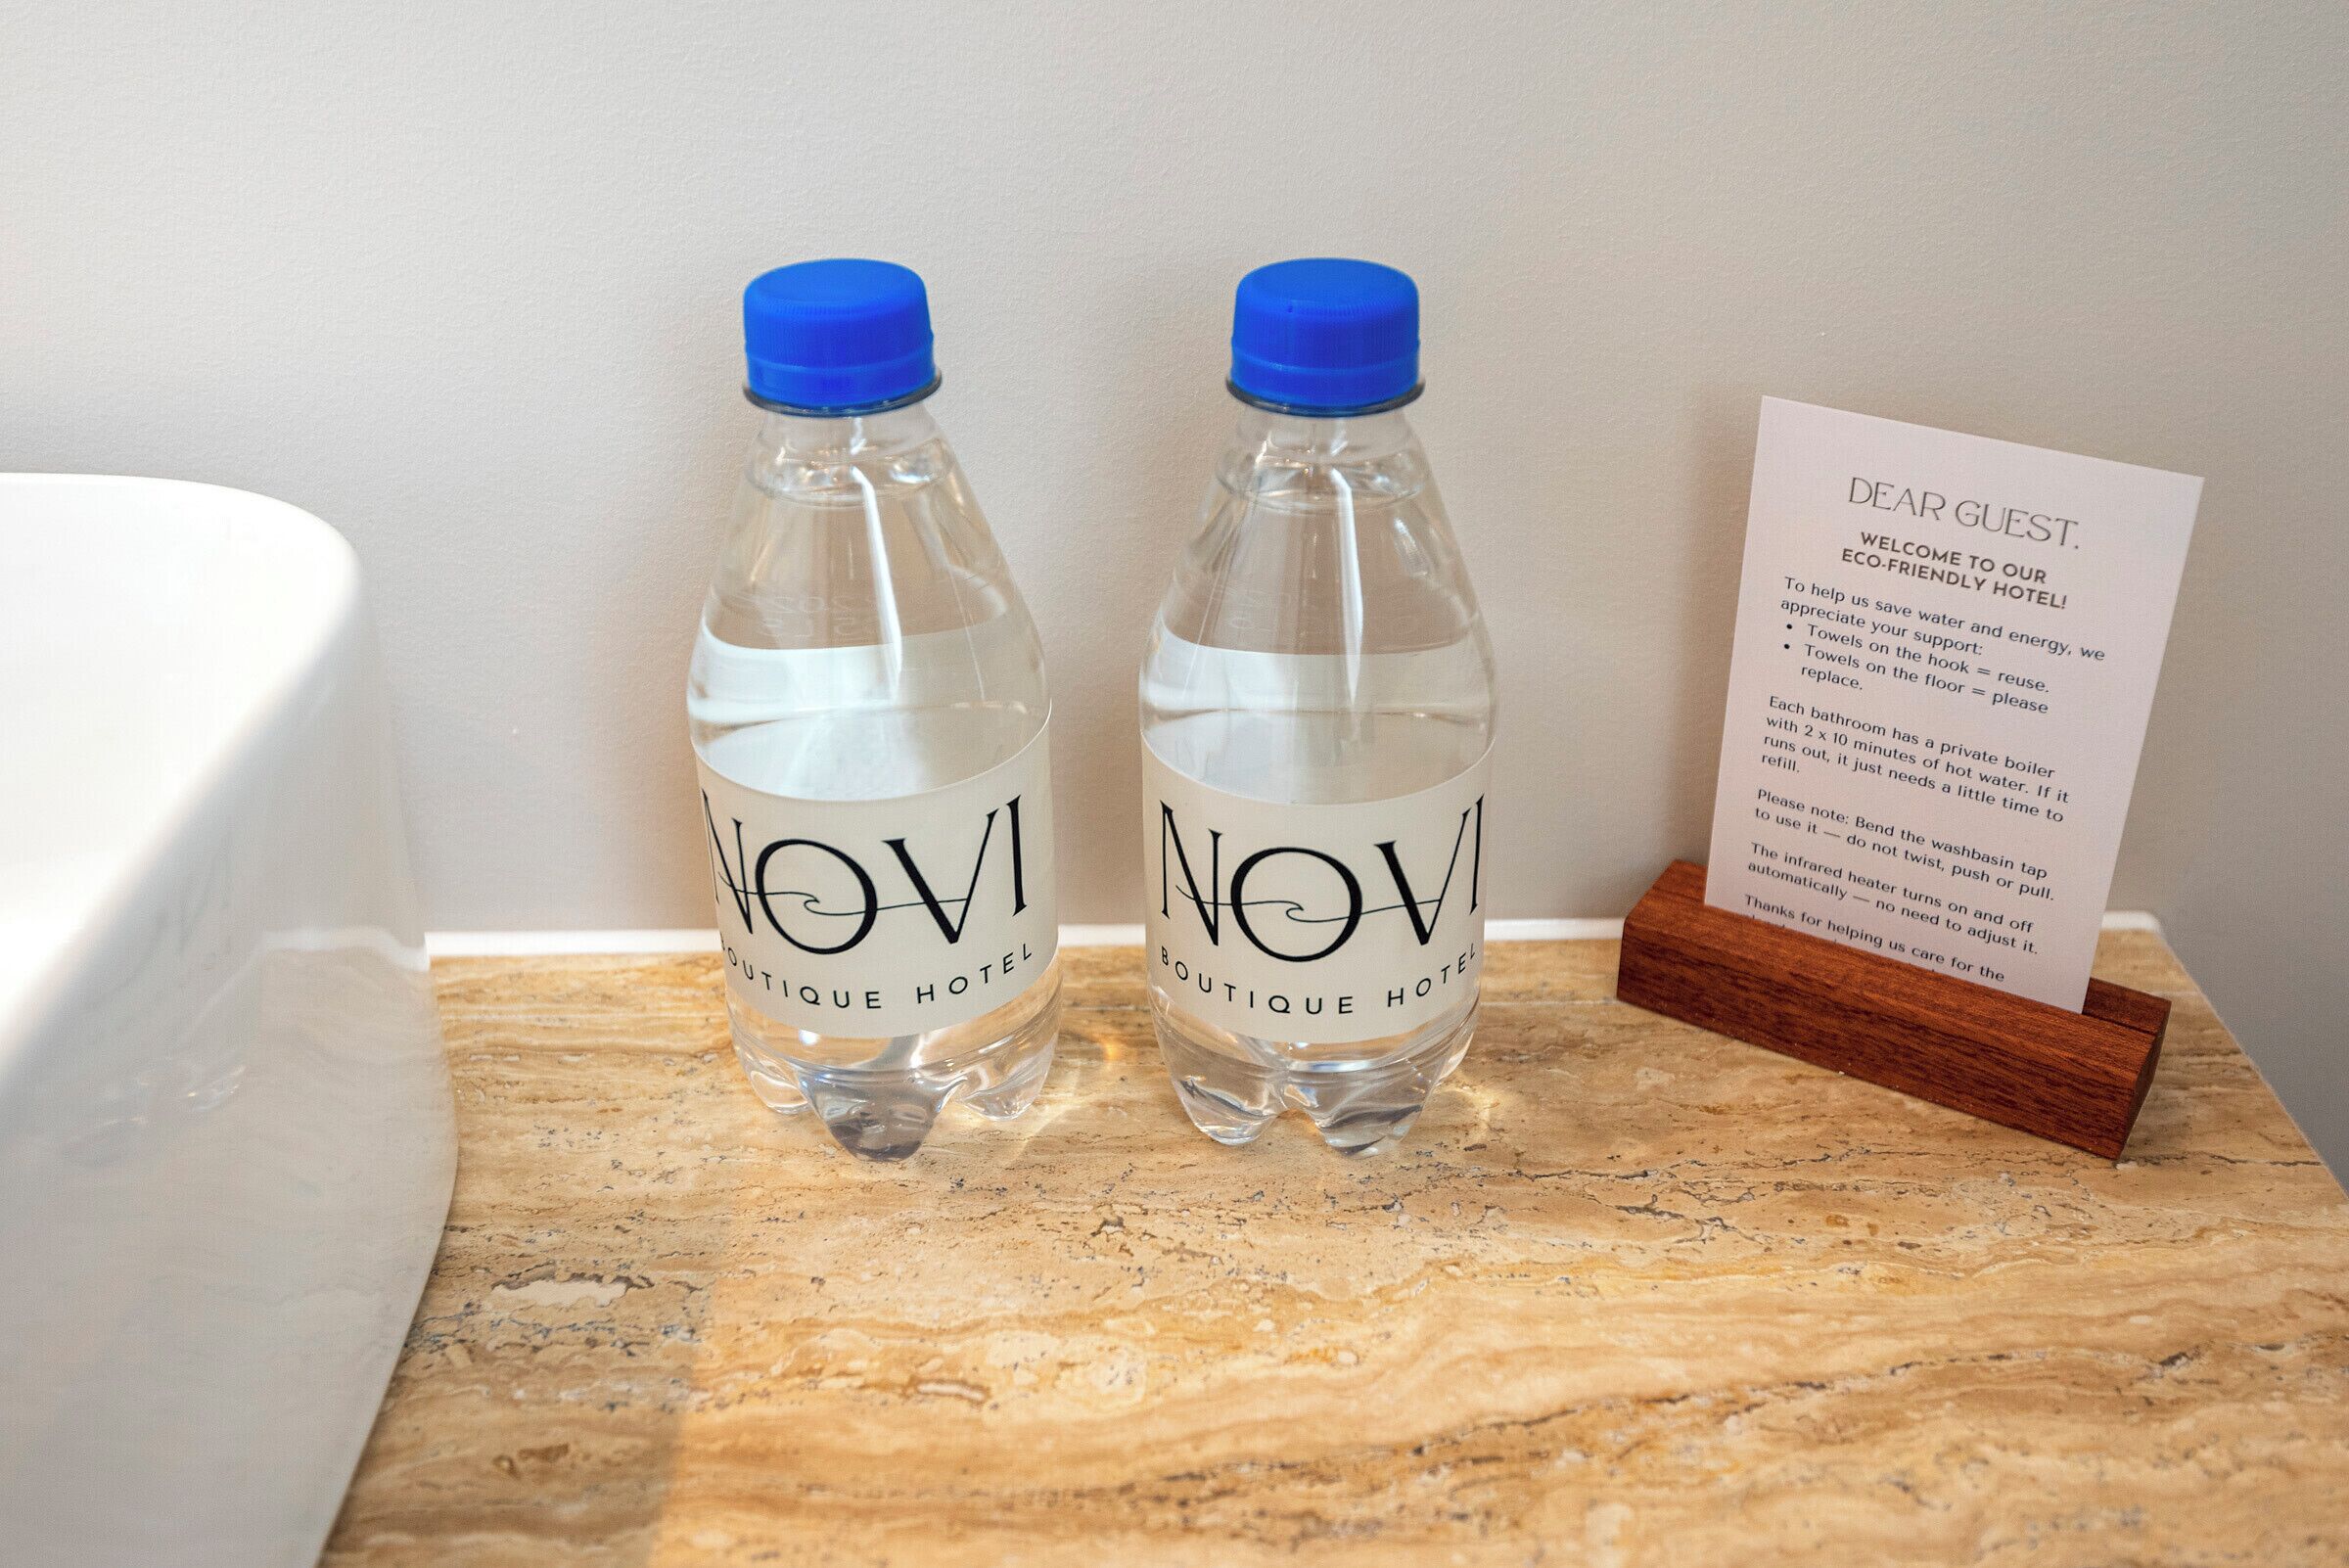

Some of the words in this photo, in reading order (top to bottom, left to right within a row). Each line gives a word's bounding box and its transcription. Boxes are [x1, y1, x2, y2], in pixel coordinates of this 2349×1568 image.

[1848, 476, 1947, 521] DEAR
[1954, 499, 2079, 550] GUEST.
[1840, 547, 1988, 591] ECO-FRIENDLY
[1992, 580, 2067, 610] HOTEL!
[1860, 530, 1962, 567] WELCOME
[1967, 554, 1996, 573] TO
[2001, 562, 2047, 584] OUR
[1779, 599, 1866, 628] appreciate
[1868, 621, 1910, 638] your
[1911, 630, 1983, 656] support:
[1783, 576, 1806, 593] To
[1810, 582, 1845, 605] help
[1850, 594, 1869, 609] us
[1873, 600, 1912, 618] save
[1917, 610, 1965, 629] water
[1968, 622, 2004, 638] and
[2007, 630, 2072, 657] energy,
[2079, 646, 2105, 662] we
[1806, 623, 1863, 649] Towels
[1867, 641, 1889, 655] on
[1895, 645, 1922, 663] the
[1926, 651, 1969, 674] hook
[1997, 672, 2050, 693] reuse.
[1801, 666, 1863, 691] replace.
[1803, 642, 1860, 669] Towels
[1865, 662, 1886, 675] on
[1892, 666, 1919, 683] the
[1924, 672, 1966, 694] floor
[1991, 692, 2049, 715] please
[1761, 754, 1800, 773] refill.
[1766, 715, 1798, 733] with
[1803, 722, 1814, 738] 2
[1817, 730, 1827, 742] x
[1831, 730, 1848, 748] 10
[1853, 739, 1916, 766] minutes
[1921, 758, 1941, 770] of
[1944, 761, 1973, 779] hot
[1978, 772, 2029, 794] water.
[2036, 784, 2052, 799] If
[2055, 789, 2069, 804] it
[1769, 695, 1805, 715] Each
[1809, 706, 1886, 737] bathroom
[1891, 726, 1919, 746] has
[1924, 738, 1935, 749] a
[1938, 742, 1999, 765] private
[2004, 755, 2055, 778] boiler
[1764, 735, 1796, 753] runs
[1801, 746, 1830, 763] out,
[1837, 752, 1849, 766] it
[1850, 756, 1883, 776] just
[1888, 768, 1936, 790] needs
[1941, 783, 1952, 794] a
[1957, 784, 1996, 806] little
[2001, 796, 2040, 816] time
[2044, 807, 2064, 823] to
[702, 788, 1028, 955] NOVI
[1754, 807, 1771, 821] to
[1775, 813, 1802, 830] use
[1807, 820, 1818, 835] it
[1846, 834, 1866, 849] do
[1871, 841, 1899, 857] not
[1903, 849, 1945, 872] twist,
[1951, 864, 1990, 883] push
[1995, 877, 2014, 889] or
[2017, 882, 2054, 900] pull.
[1757, 788, 1805, 812] Please
[1810, 806, 1849, 825] note:
[1855, 815, 1895, 837] Bend
[1900, 828, 1925, 846] the
[1930, 839, 2014, 870] washbasin
[2020, 861, 2048, 882] tap
[1159, 794, 1485, 963] NOVI
[1747, 861, 1848, 901] automatically
[1874, 899, 1896, 913] no
[1900, 906, 1940, 926] need
[1945, 917, 1962, 932] to
[1966, 926, 2017, 948] adjust
[2022, 940, 2038, 954] it.
[1750, 841, 1778, 860] The
[1783, 851, 1843, 880] infrared
[1847, 869, 1898, 895] heater
[1902, 887, 1942, 908] turns
[1947, 901, 1968, 916] on
[1972, 908, 2004, 926] and
[2008, 919, 2035, 934] off
[916, 943, 1033, 1005] HOTEL
[1160, 945, 1354, 1015] BOUTIQUE
[1387, 943, 1476, 1008] HOTEL
[1744, 894, 1795, 919] Thanks
[1800, 911, 1823, 927] for
[1826, 919, 1883, 949] helping
[1888, 939, 1906, 953] us
[1911, 946, 1945, 964] care
[1950, 955, 1974, 973] for
[1979, 965, 2004, 983] the
